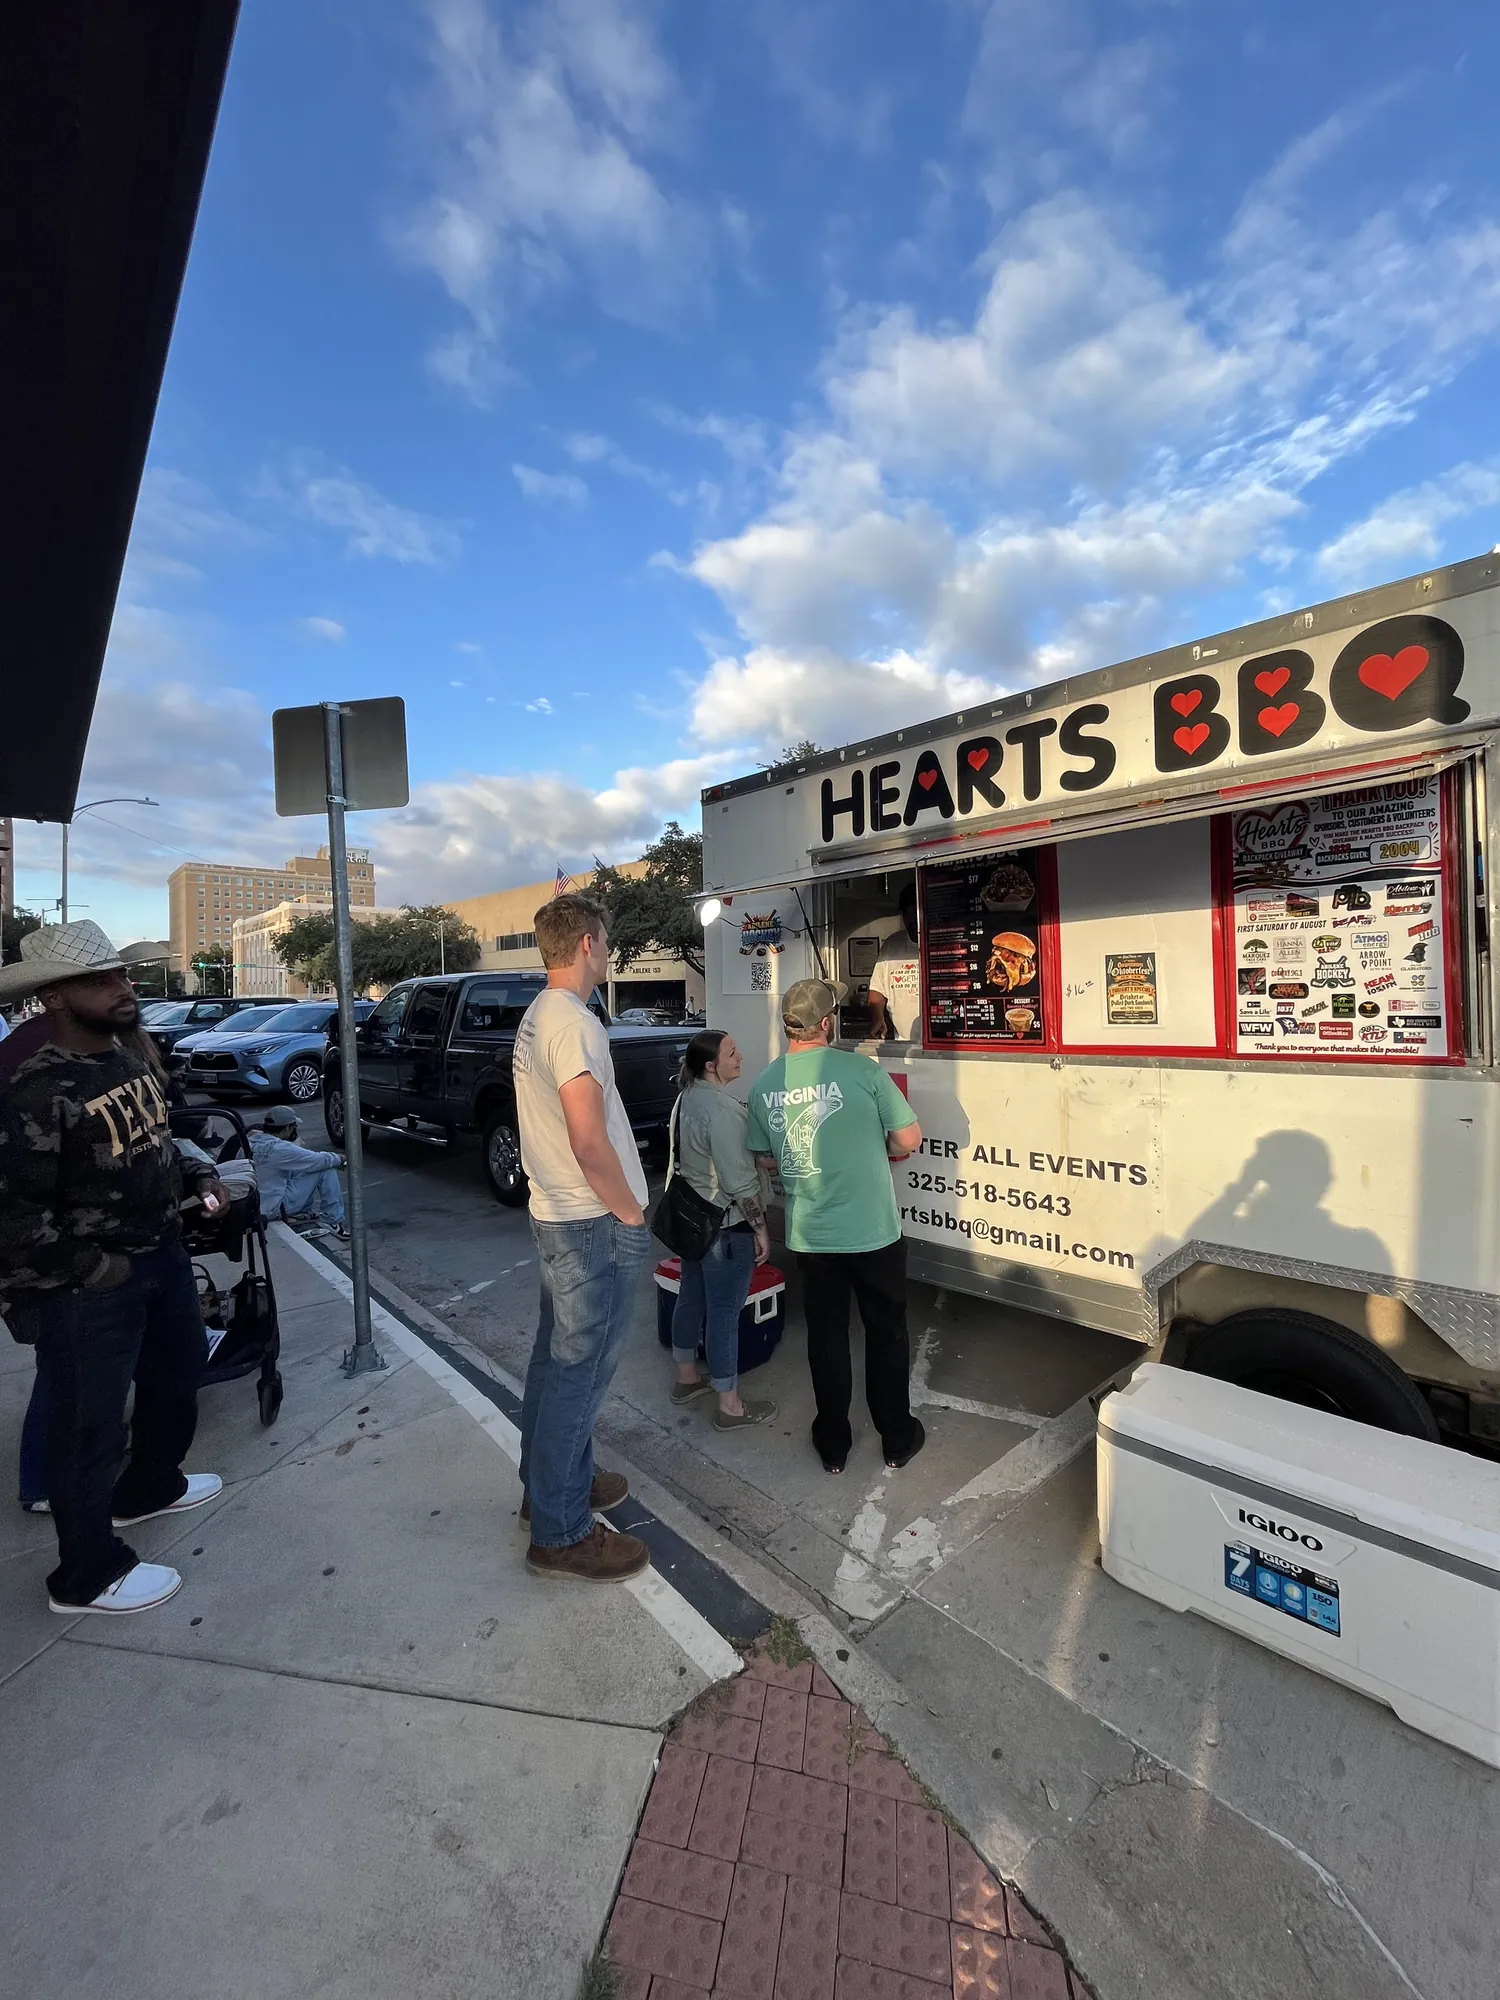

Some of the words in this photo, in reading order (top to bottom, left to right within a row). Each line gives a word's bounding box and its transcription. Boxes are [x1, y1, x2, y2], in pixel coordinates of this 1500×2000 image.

[821, 703, 1116, 843] HEARTS
[1153, 615, 1471, 773] BBQ
[1321, 784, 1381, 812] THANK
[1383, 777, 1427, 801] YOU!
[1332, 811, 1344, 821] TO
[1346, 808, 1366, 819] OUR
[1369, 800, 1414, 816] AMAZING
[1239, 809, 1311, 849] Hearts
[1313, 820, 1347, 833] SPONSORS,
[1348, 815, 1385, 828] CUSTOMERS
[1386, 814, 1392, 823] &
[1393, 808, 1435, 823] VOLUNTEERS
[1334, 830, 1349, 838] MAKE
[1395, 821, 1425, 832] BACKPACK
[1261, 838, 1286, 850] BBQ
[1380, 840, 1420, 859] 2004
[1242, 852, 1273, 863] BACKPACK
[1274, 847, 1304, 860] GIVEAWAY
[1317, 852, 1350, 864] BACKPACKS
[1350, 850, 1369, 860] GIVEN:
[1237, 925, 1254, 933] FIRST
[1255, 923, 1288, 932] SATURDAY
[1290, 922, 1298, 930] OF
[1300, 920, 1327, 929] AUGUST
[1276, 939, 1304, 947] HANNA
[1353, 934, 1387, 944] ATMOS
[1359, 950, 1386, 959] ARROW
[1369, 959, 1392, 968] POINT
[1316, 968, 1349, 980] HOCKEY
[1363, 973, 1395, 989] KEAN
[1241, 1023, 1272, 1033] VFW
[1276, 1044, 1290, 1052] you
[1298, 1045, 1330, 1053] everyone
[1330, 1044, 1345, 1052] that
[1345, 1045, 1369, 1053] makes
[1370, 1044, 1384, 1053] this
[1384, 1046, 1419, 1056] possible!
[761, 1081, 844, 1109] VIRGINIA
[84, 1074, 167, 1158] TEXA
[911, 1137, 960, 1159] TER
[972, 1144, 1020, 1169] ALL
[1029, 1151, 1148, 1186] EVENTS
[907, 1170, 1073, 1217] 325-518-5643
[900, 1205, 1136, 1270] rtsbbq@gmail.com
[1238, 1508, 1324, 1552] IGLOO
[1229, 1551, 1251, 1578] 7
[1259, 1549, 1303, 1574] IGLOO
[1229, 1573, 1250, 1589] DAYS
[1312, 1592, 1333, 1606] 150
